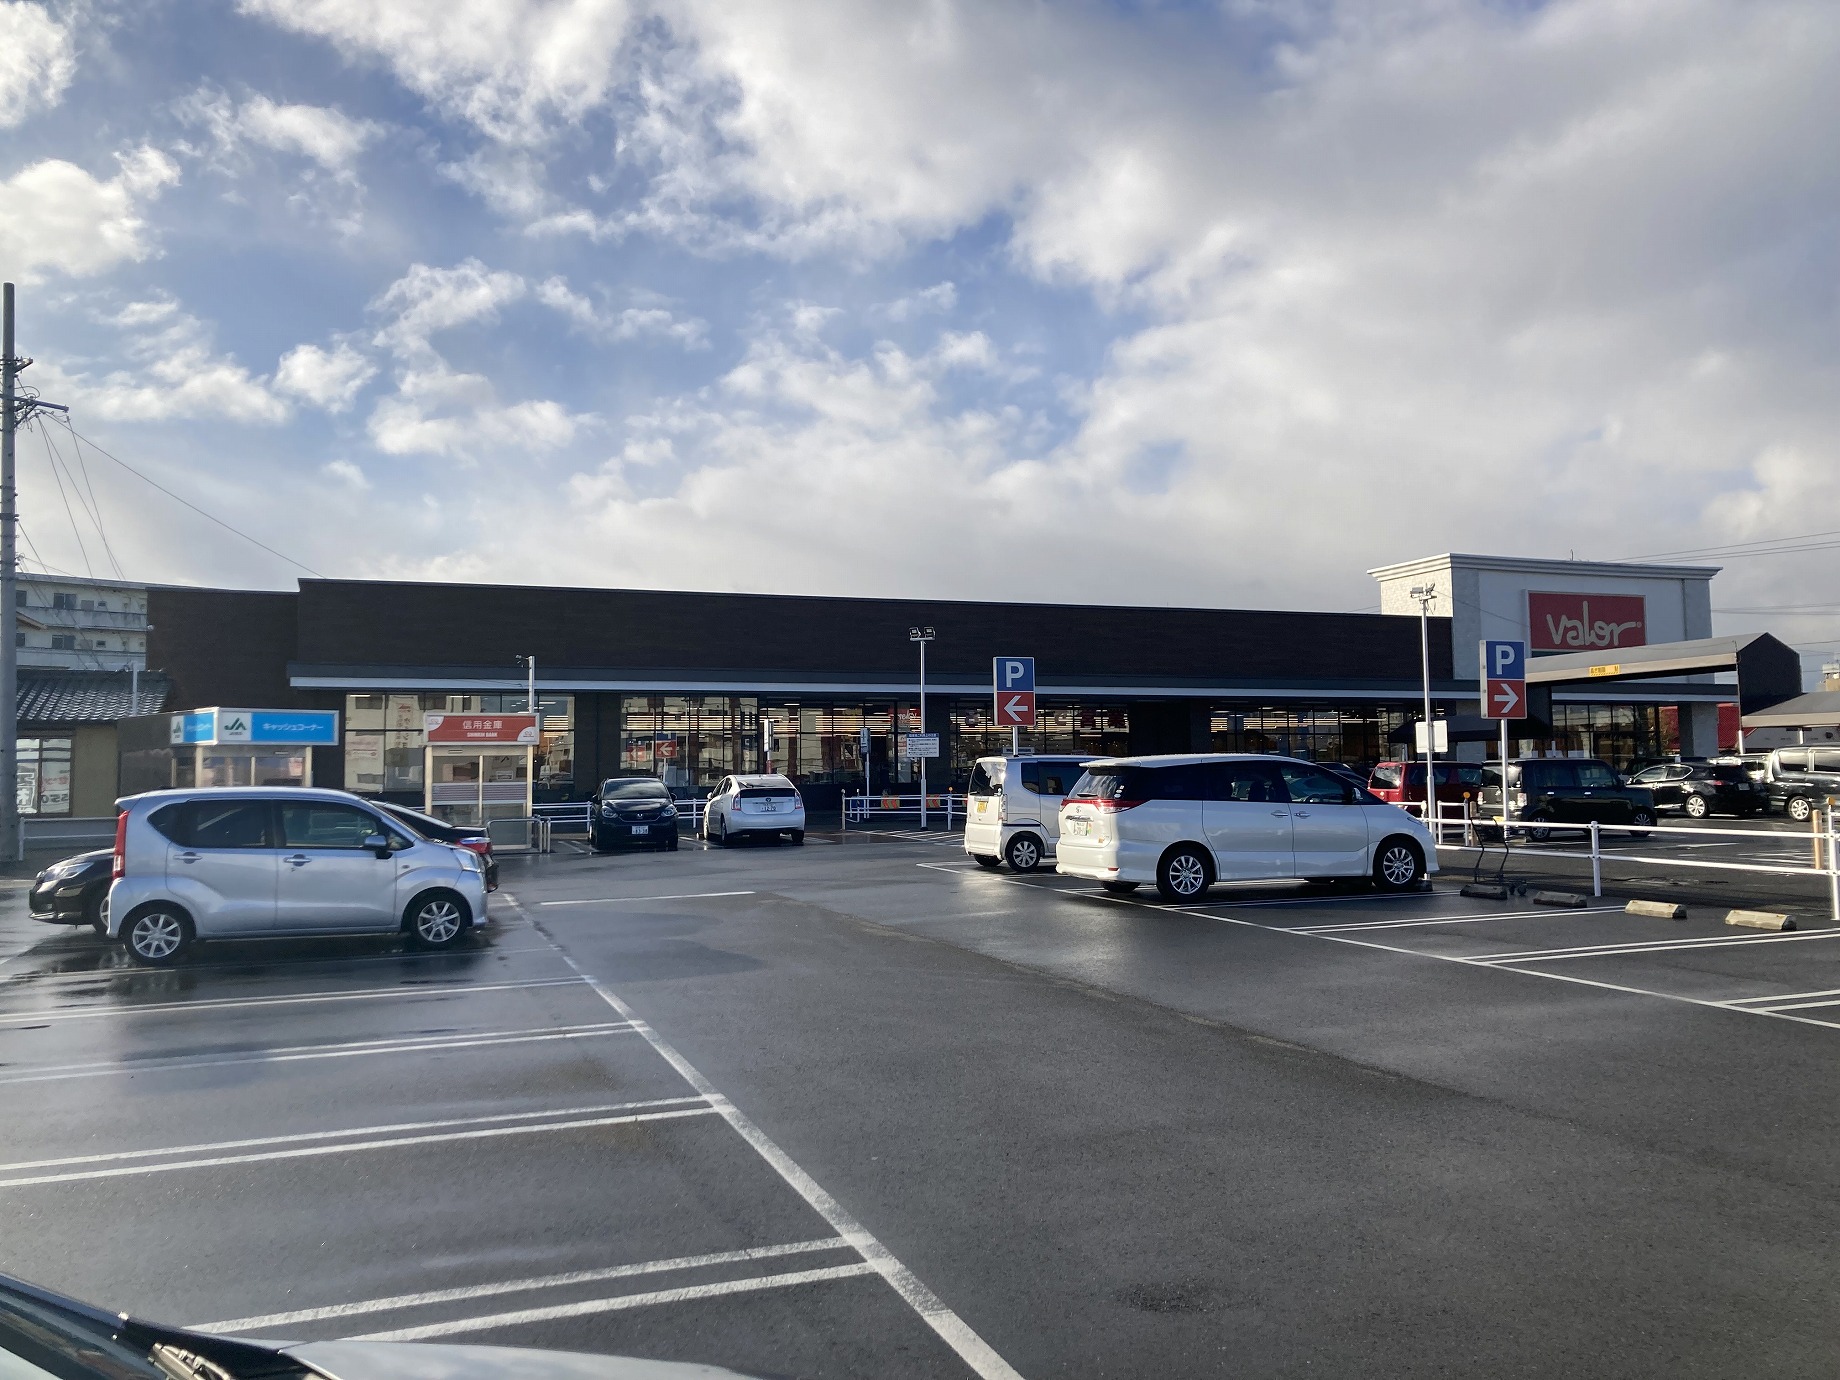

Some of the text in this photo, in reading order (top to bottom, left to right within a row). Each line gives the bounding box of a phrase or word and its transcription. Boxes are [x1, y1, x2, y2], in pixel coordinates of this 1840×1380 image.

[1495, 644, 1515, 675] P
[1005, 661, 1025, 688] P
[224, 717, 247, 731] JA
[462, 720, 503, 730] 信用金庫
